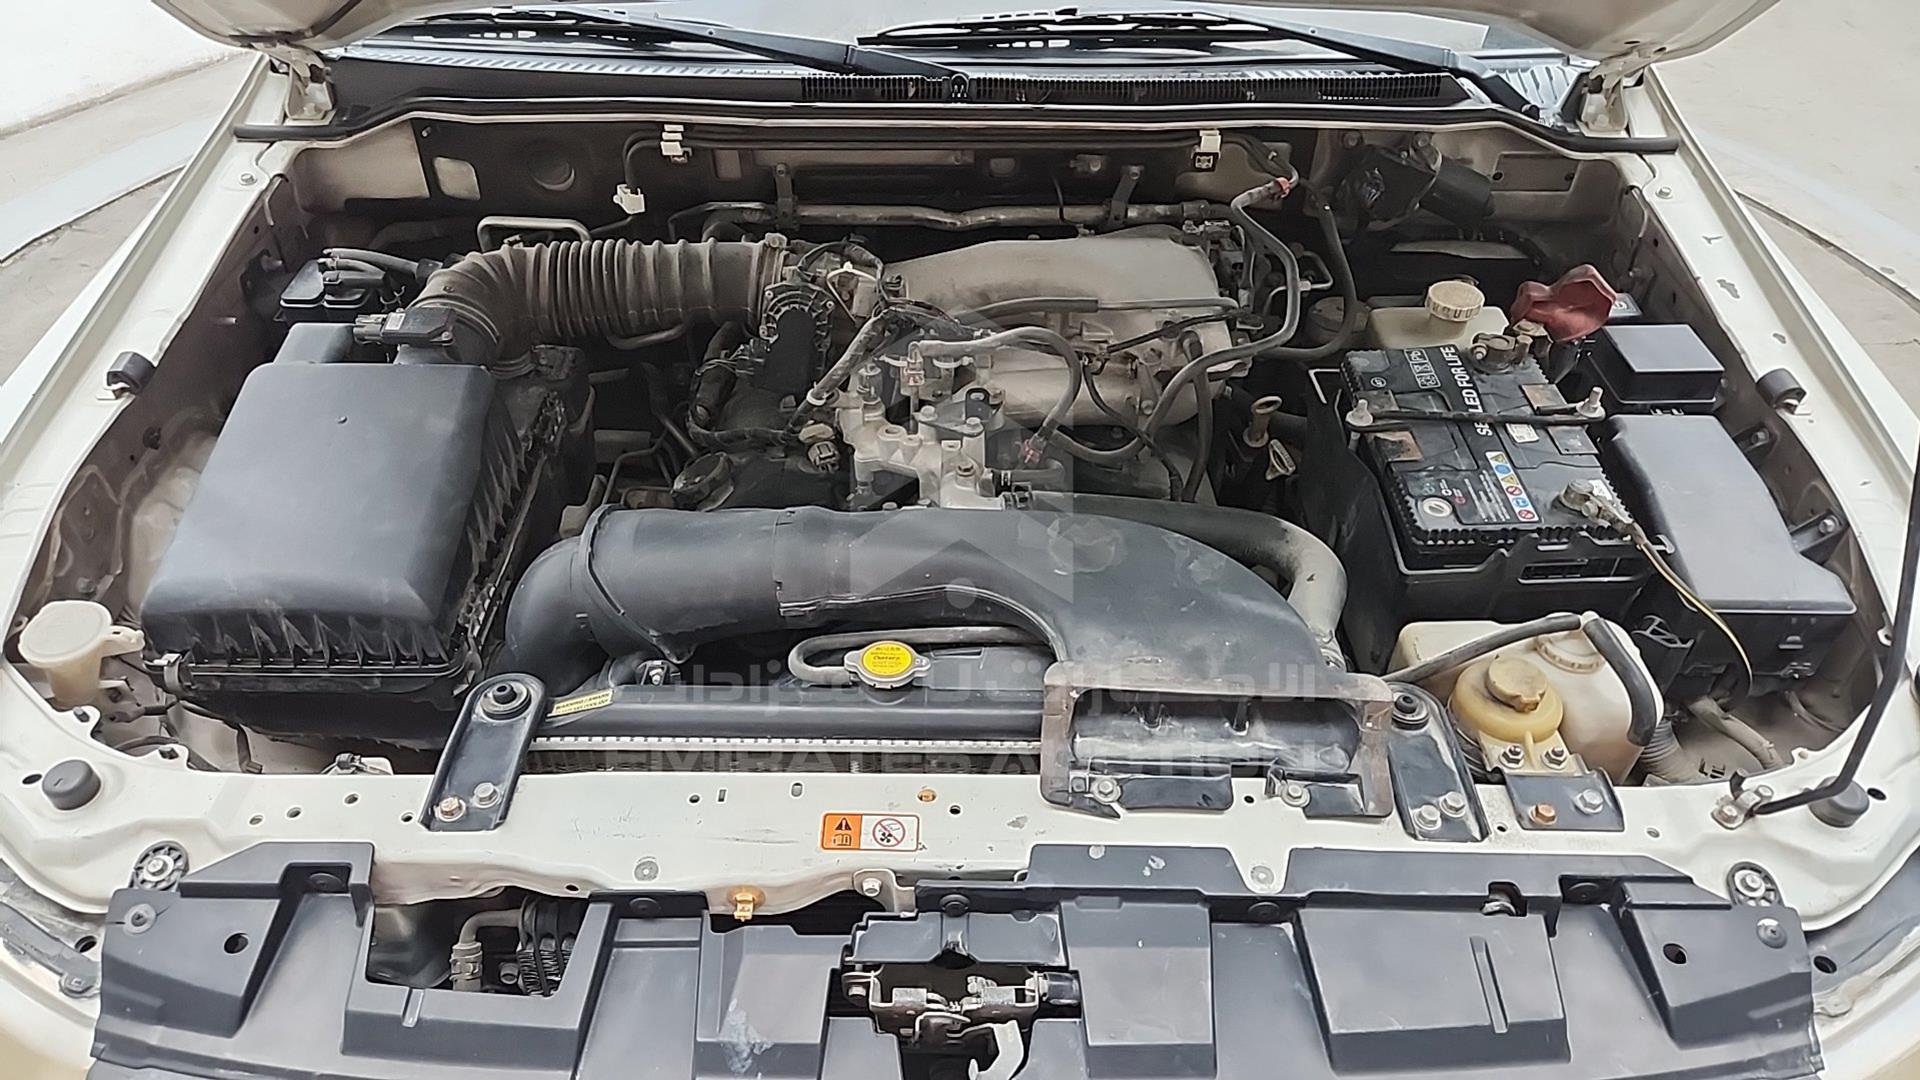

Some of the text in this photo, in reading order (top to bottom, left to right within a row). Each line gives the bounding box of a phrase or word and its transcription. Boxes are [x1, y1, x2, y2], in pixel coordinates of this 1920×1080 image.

[1439, 345, 1493, 437] SELED FOR LIFE
